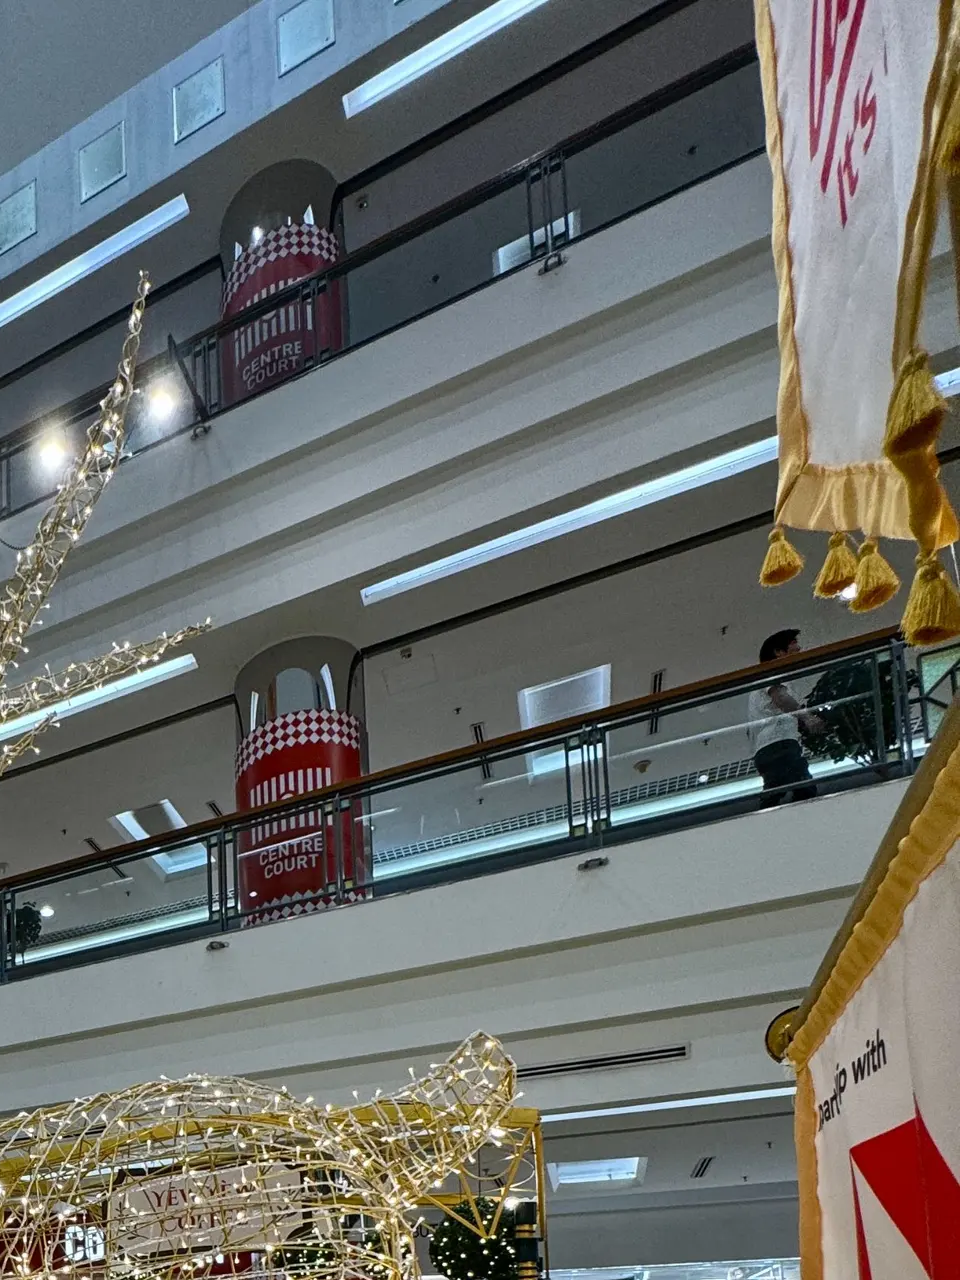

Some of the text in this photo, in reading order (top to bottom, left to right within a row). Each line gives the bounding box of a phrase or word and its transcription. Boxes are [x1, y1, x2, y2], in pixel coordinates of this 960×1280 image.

[243, 341, 302, 381] CENTRE
[247, 355, 299, 391] COURT
[259, 837, 323, 866] CENTRE
[264, 853, 319, 879] COURT
[851, 1028, 887, 1084] with
